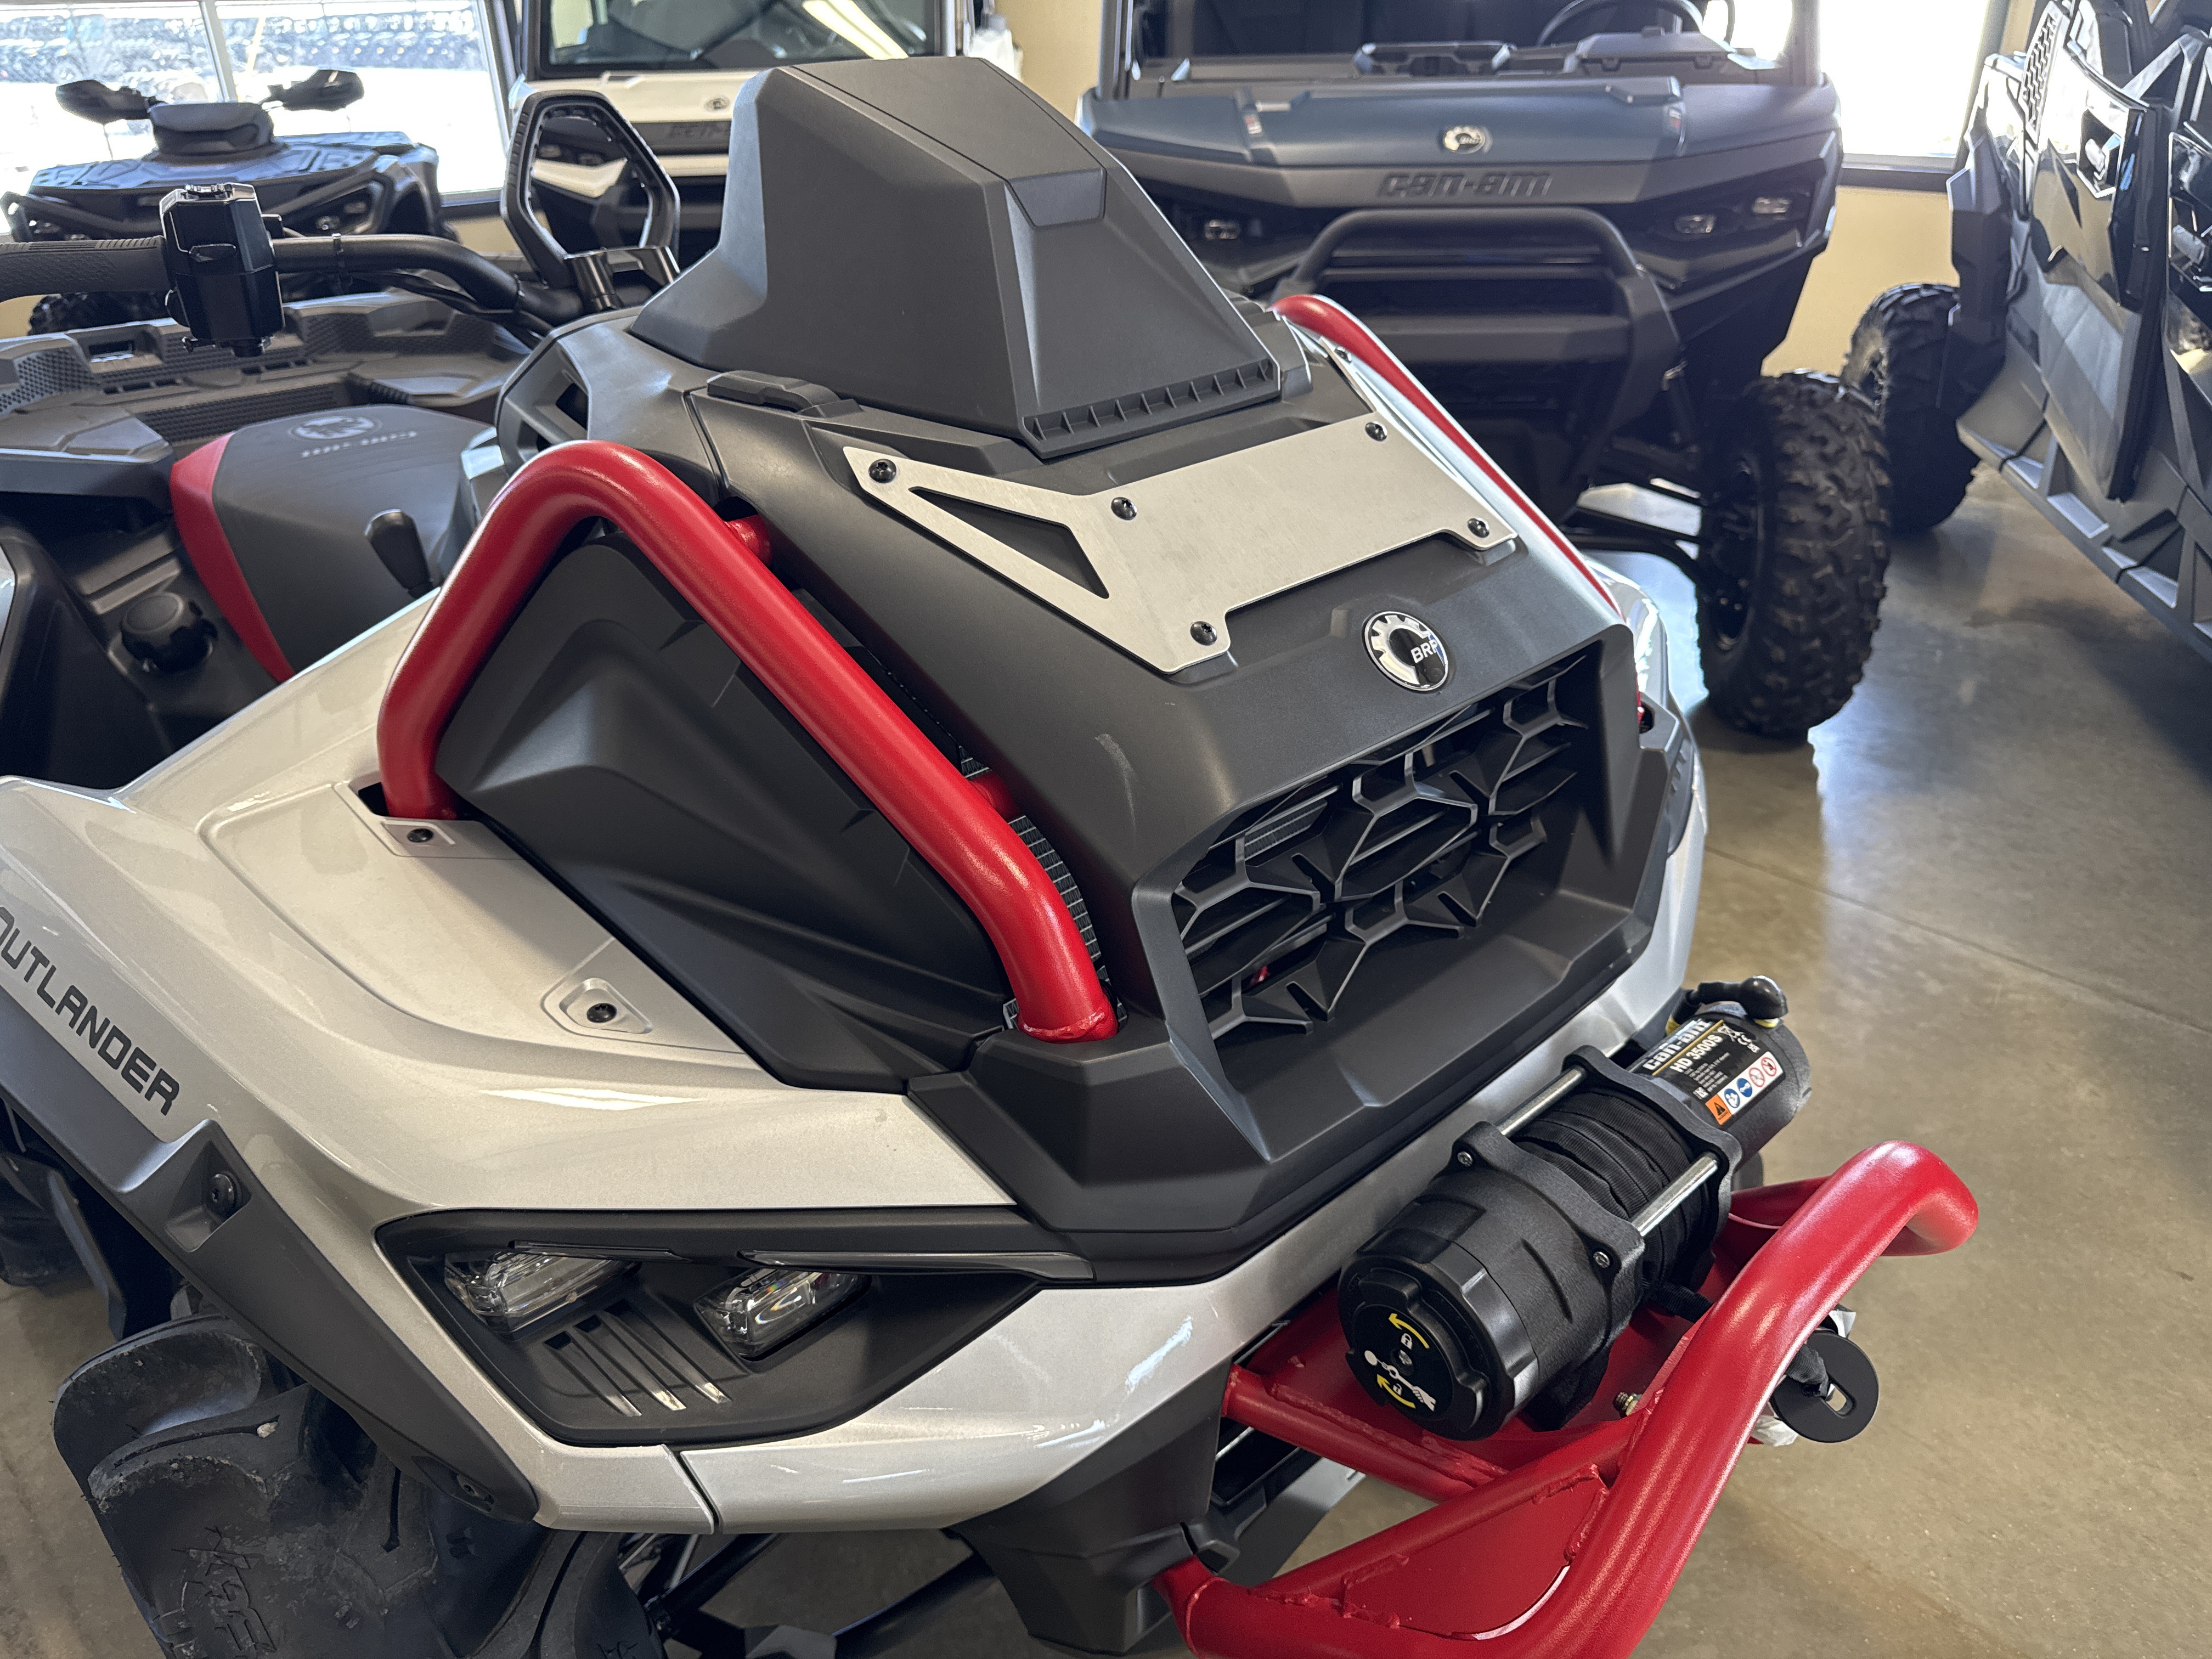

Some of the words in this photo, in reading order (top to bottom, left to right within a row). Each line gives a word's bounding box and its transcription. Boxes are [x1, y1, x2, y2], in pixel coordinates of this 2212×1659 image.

[1376, 171, 1553, 198] can-am
[1410, 639, 1438, 664] BRP
[1643, 1020, 1712, 1070] can-am
[1669, 1058, 1693, 1073] HD
[1686, 1034, 1723, 1060] 3500S
